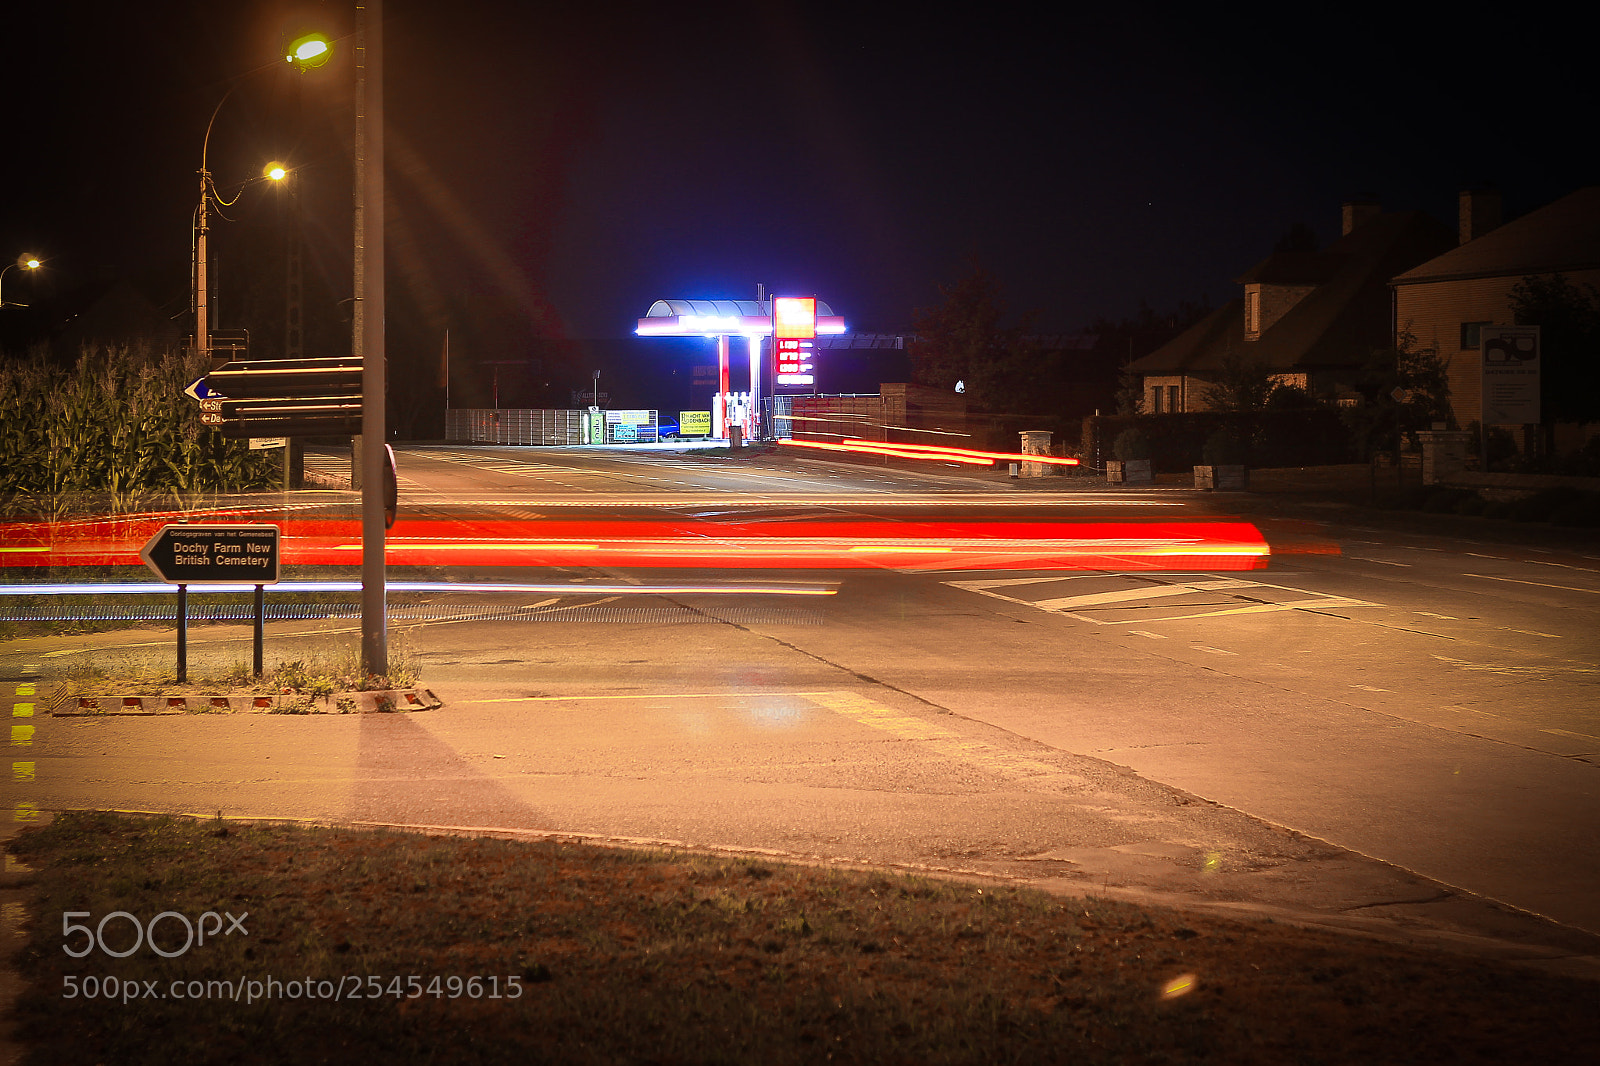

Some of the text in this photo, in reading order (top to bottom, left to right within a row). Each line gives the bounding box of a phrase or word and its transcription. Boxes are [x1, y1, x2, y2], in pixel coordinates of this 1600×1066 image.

[174, 542, 271, 554] Dochy Farm New
[176, 555, 269, 567] British Cemetery
